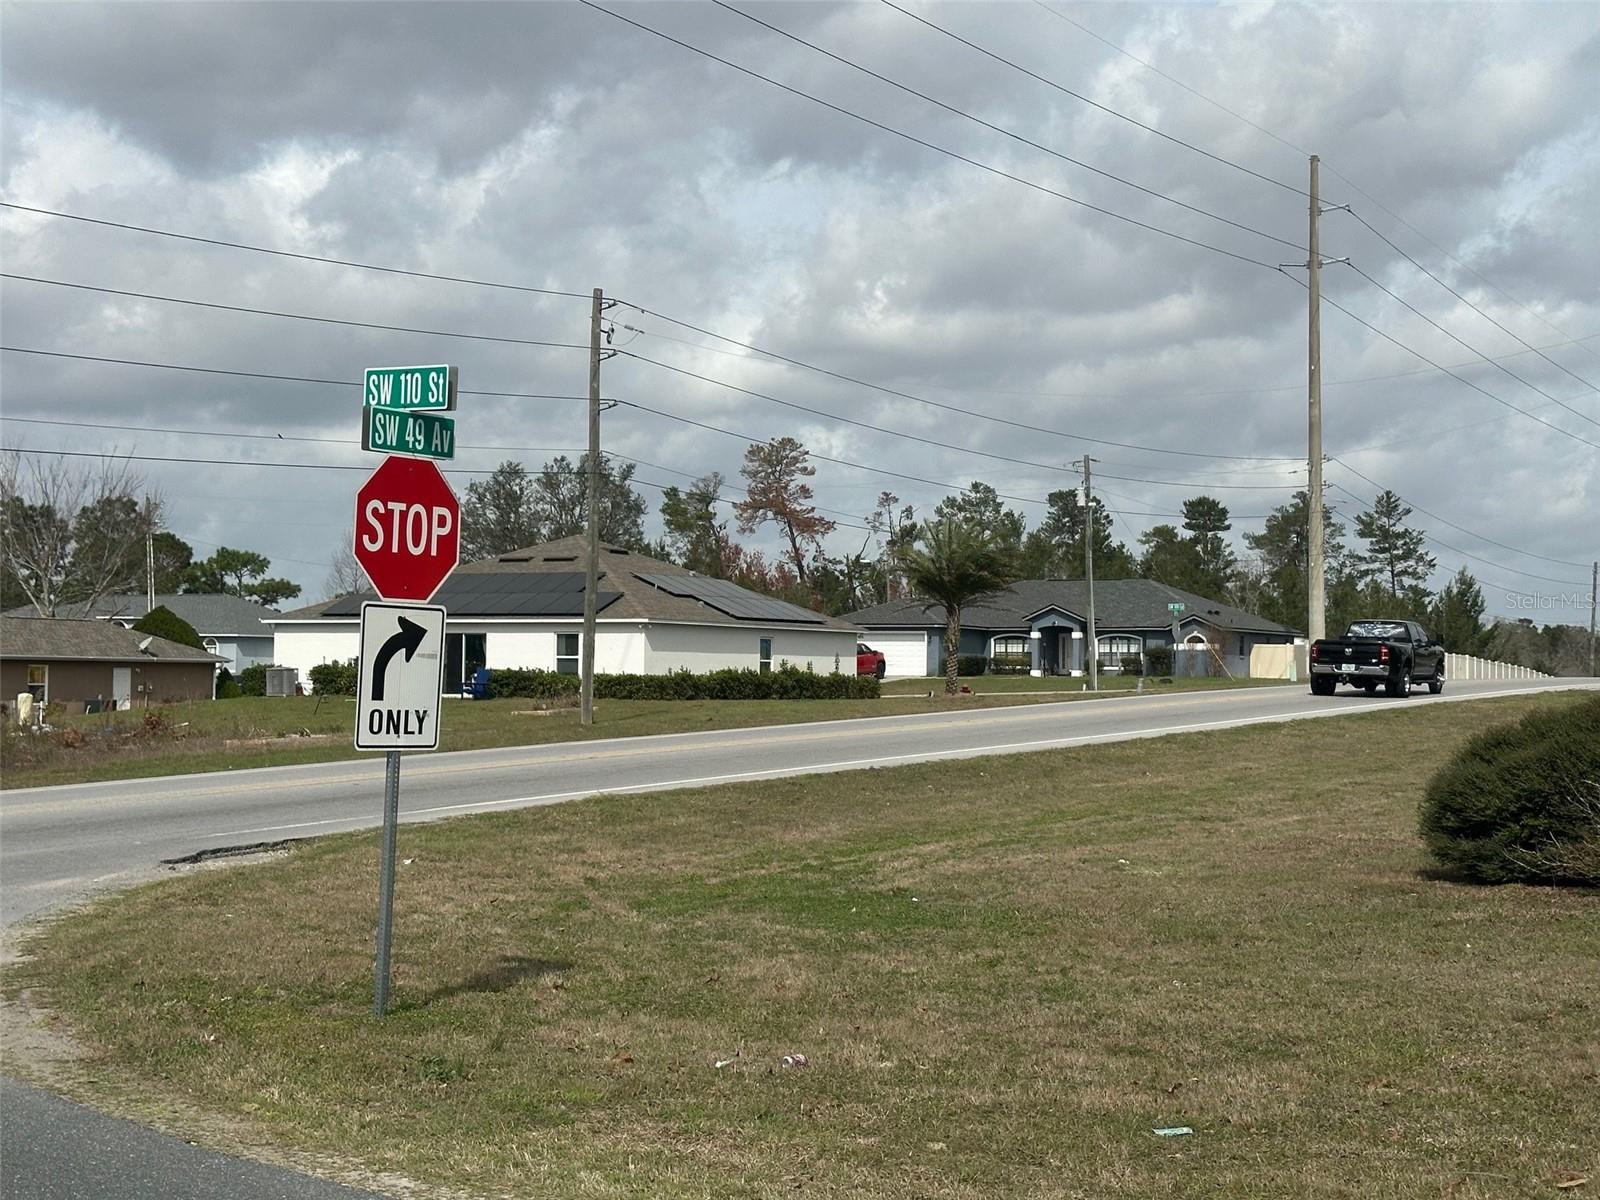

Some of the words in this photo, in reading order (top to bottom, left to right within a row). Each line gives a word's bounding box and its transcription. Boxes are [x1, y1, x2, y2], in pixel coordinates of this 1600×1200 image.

[368, 374, 394, 405] SW
[400, 372, 421, 404] 110
[428, 371, 444, 403] St
[375, 413, 399, 446] SW
[405, 417, 425, 450] 49
[431, 421, 451, 453] Av
[362, 499, 452, 557] STOP
[368, 708, 428, 736] ONLY
